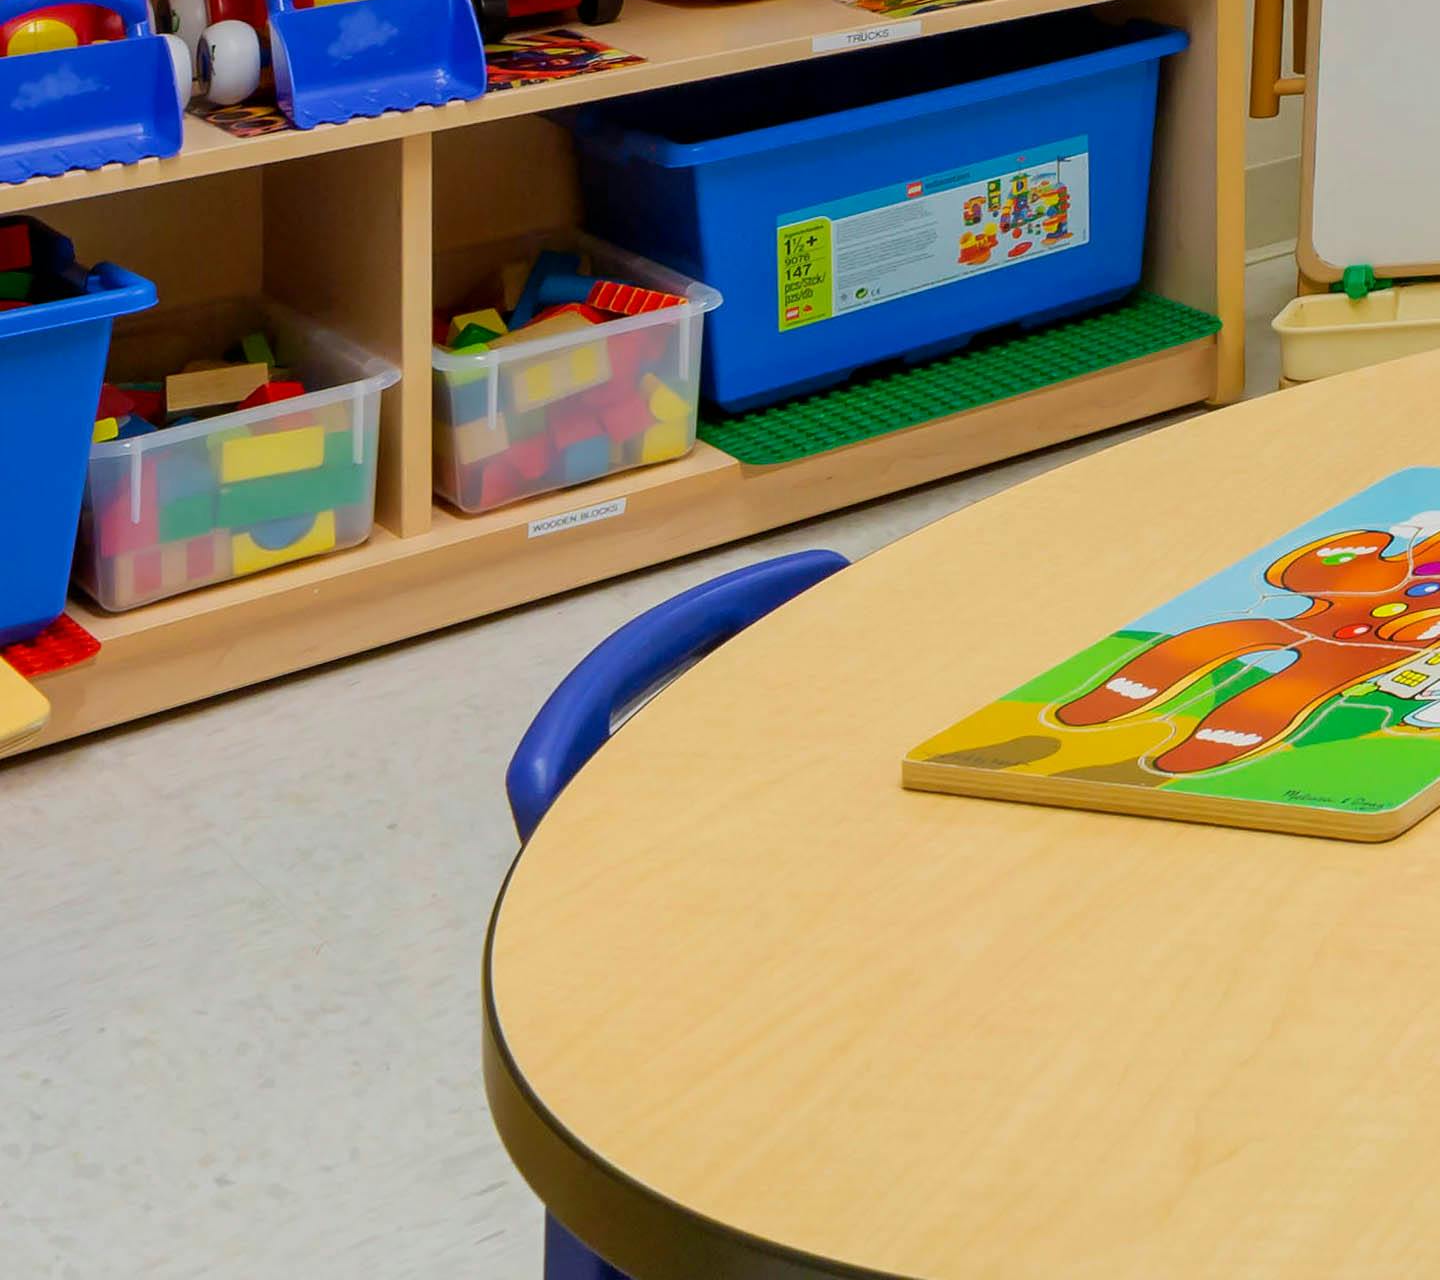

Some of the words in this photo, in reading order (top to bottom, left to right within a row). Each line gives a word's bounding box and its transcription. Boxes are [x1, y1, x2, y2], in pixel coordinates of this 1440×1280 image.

[847, 28, 889, 44] TRUCKS
[786, 263, 812, 281] 147
[532, 515, 577, 533] WOODEN
